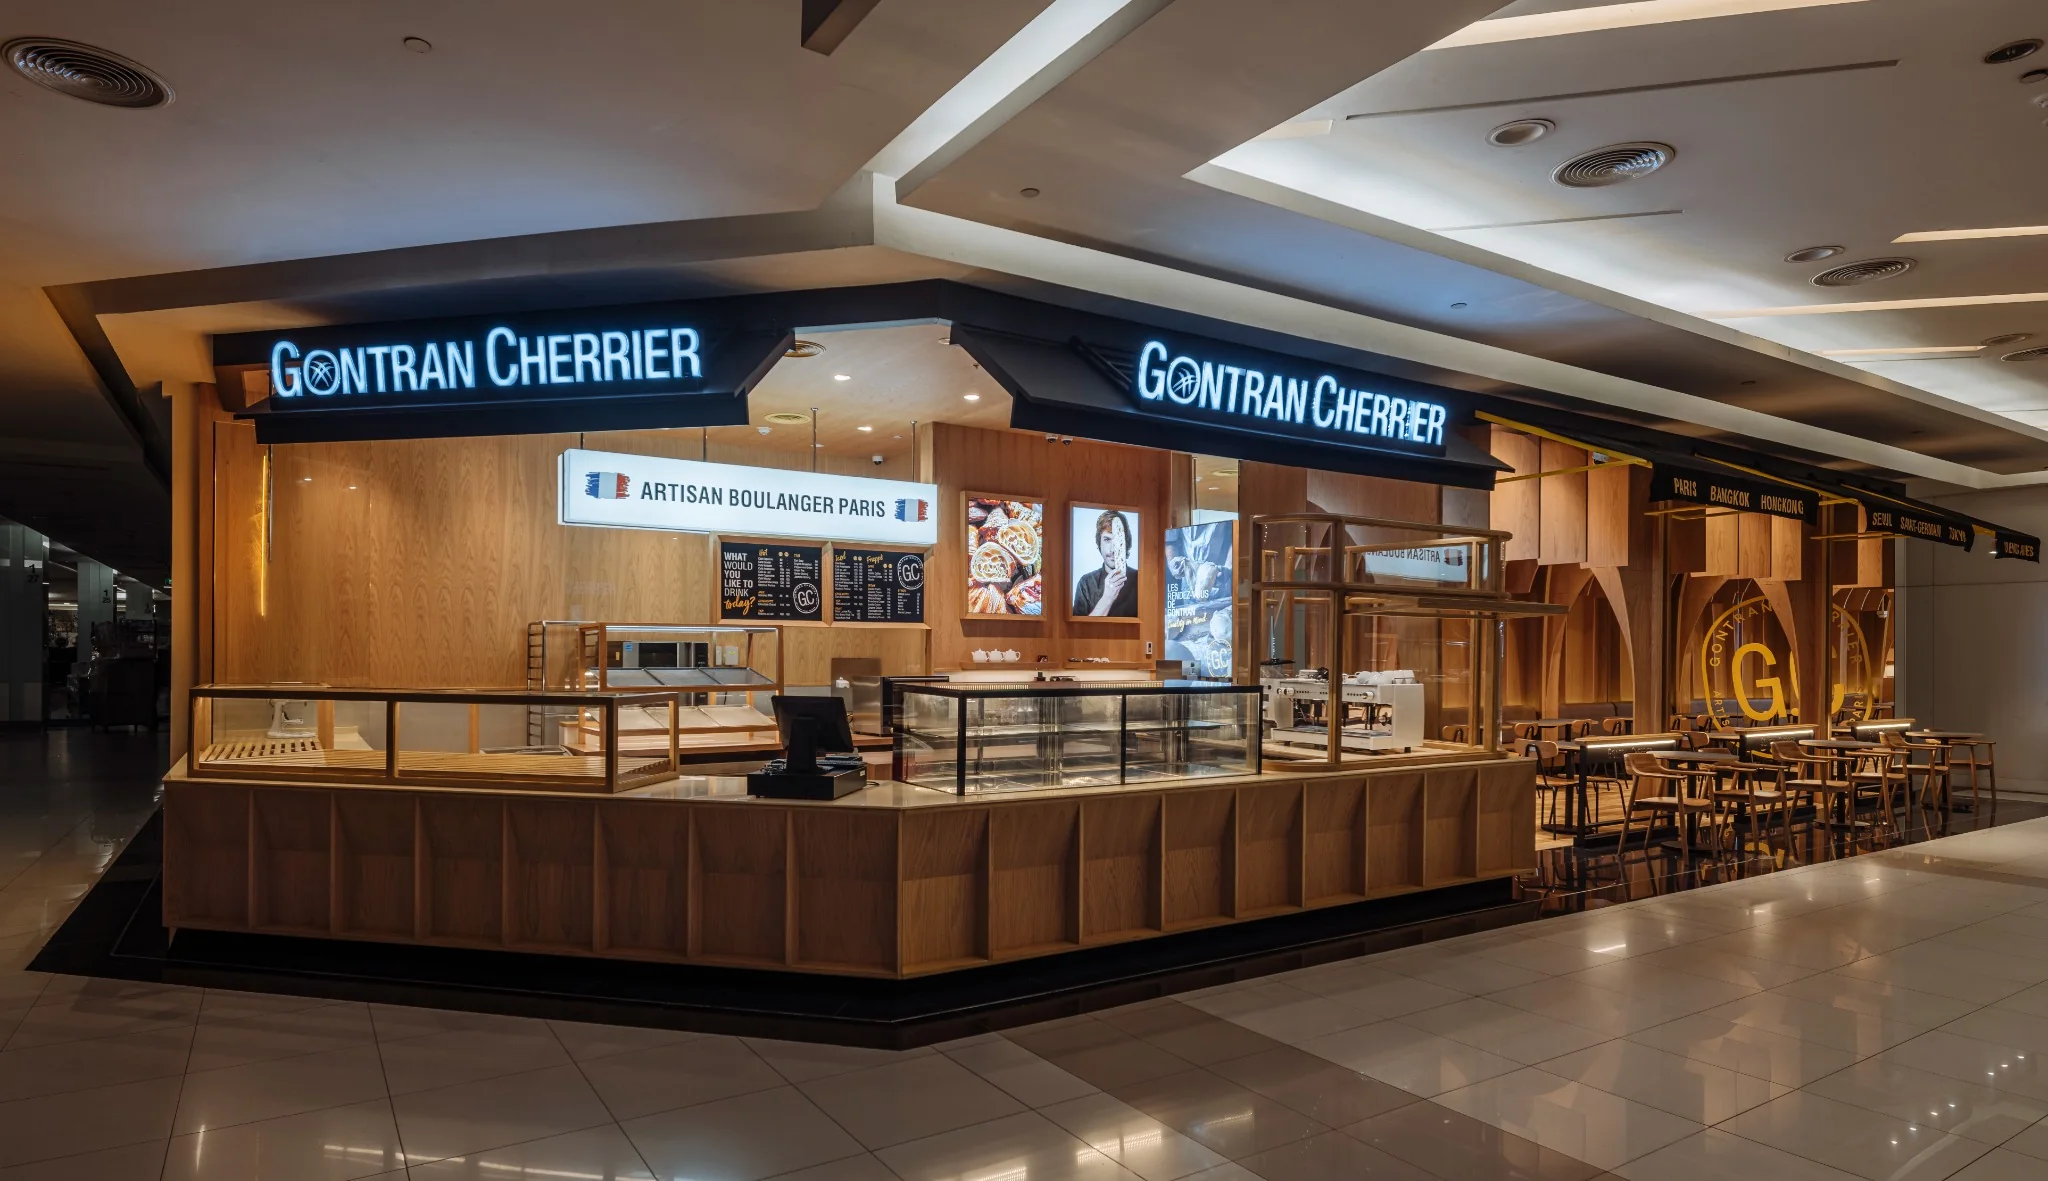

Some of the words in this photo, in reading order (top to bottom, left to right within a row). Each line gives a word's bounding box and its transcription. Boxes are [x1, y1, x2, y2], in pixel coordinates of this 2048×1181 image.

[270, 339, 477, 398] GONTRAN
[486, 326, 703, 387] CHERRIER
[1137, 340, 1308, 424] GONTRAN
[1312, 374, 1447, 446] CHERRIER
[640, 481, 723, 506] ARTISAN
[729, 490, 834, 515] BOULANGER
[839, 498, 886, 518] PARIS
[1674, 478, 1697, 497] PARIS
[1710, 486, 1750, 508] BANGKOK
[1761, 494, 1804, 515] HONGKONG
[724, 552, 748, 561] WHAT
[724, 561, 753, 570] WOULD
[724, 570, 741, 578] YOU
[724, 579, 743, 588] LIKE
[744, 580, 754, 588] TO
[1167, 584, 1178, 592] LES
[724, 588, 749, 597] DRINK
[1167, 590, 1208, 600] RENDEZ-VOUS
[724, 596, 756, 616] today?
[1167, 600, 1176, 608] DE
[1167, 607, 1196, 616] GONTRAN
